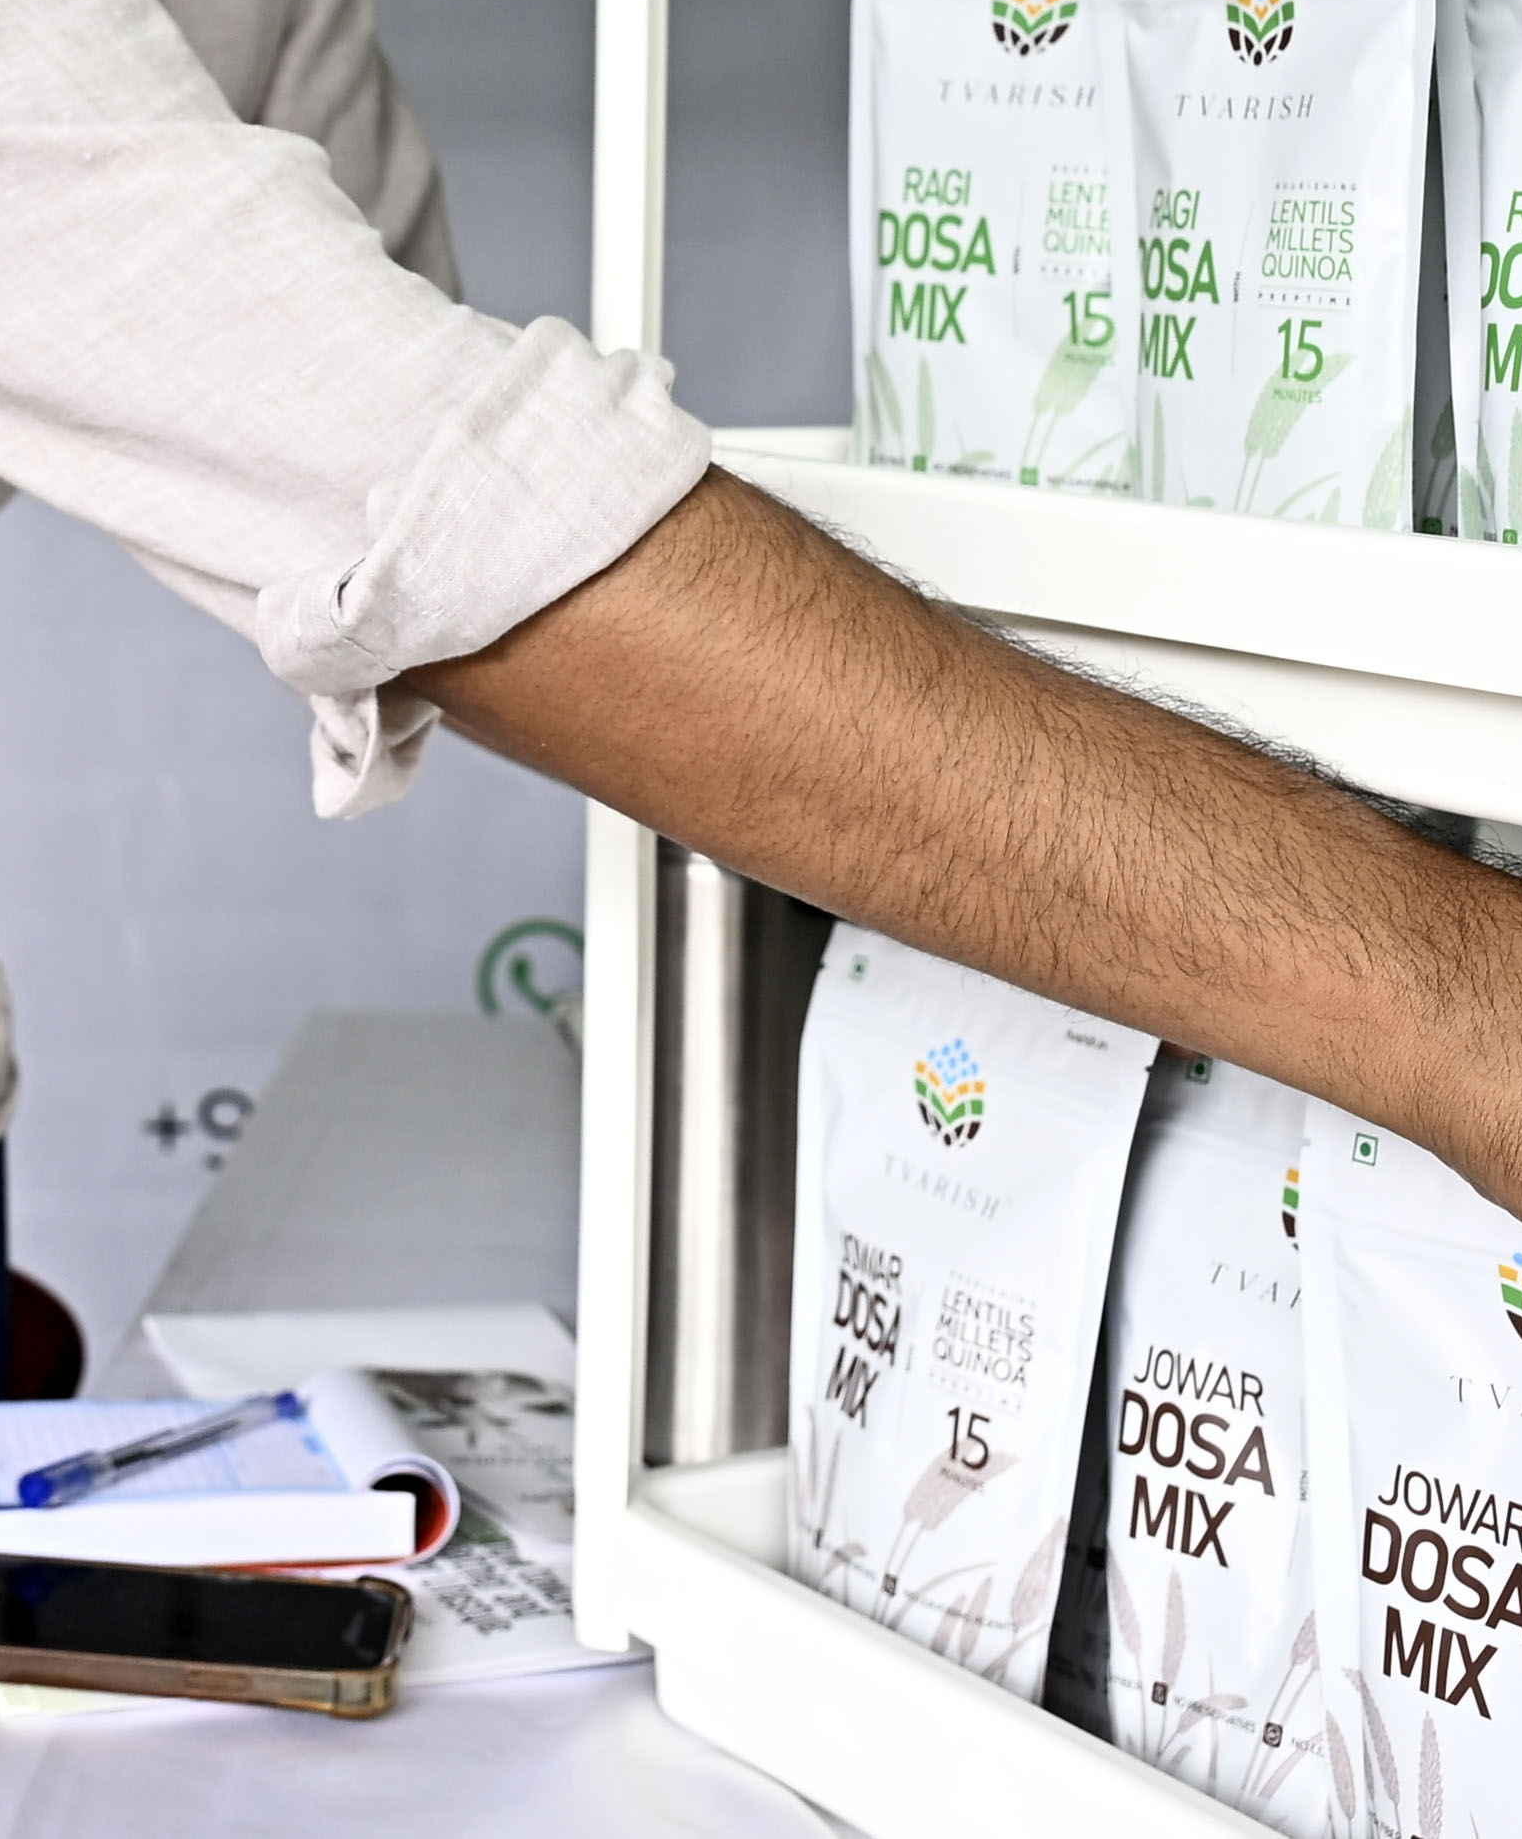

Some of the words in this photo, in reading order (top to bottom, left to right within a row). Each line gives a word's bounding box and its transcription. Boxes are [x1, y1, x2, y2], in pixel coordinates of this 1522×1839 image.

[1175, 94, 1315, 120] TVARISH
[903, 166, 972, 207] RAGI
[1150, 189, 1200, 230] RAGI
[1270, 199, 1355, 227] LENTILS
[1261, 256, 1353, 282] QUINOA
[1265, 227, 1354, 254] MILLETS
[890, 280, 968, 345] MIX
[1063, 290, 1115, 348] 15
[1139, 313, 1197, 380] MIX
[1277, 318, 1325, 382] 15
[833, 1269, 901, 1368] DOSA
[941, 1285, 1034, 1339] LENTILS
[933, 1335, 1027, 1389] QUINOA
[1133, 1345, 1265, 1417] JOWAR
[947, 1405, 991, 1472] 15
[1118, 1389, 1276, 1497] DOSA
[1129, 1474, 1236, 1569] MIX
[1382, 1605, 1498, 1721] MIX
